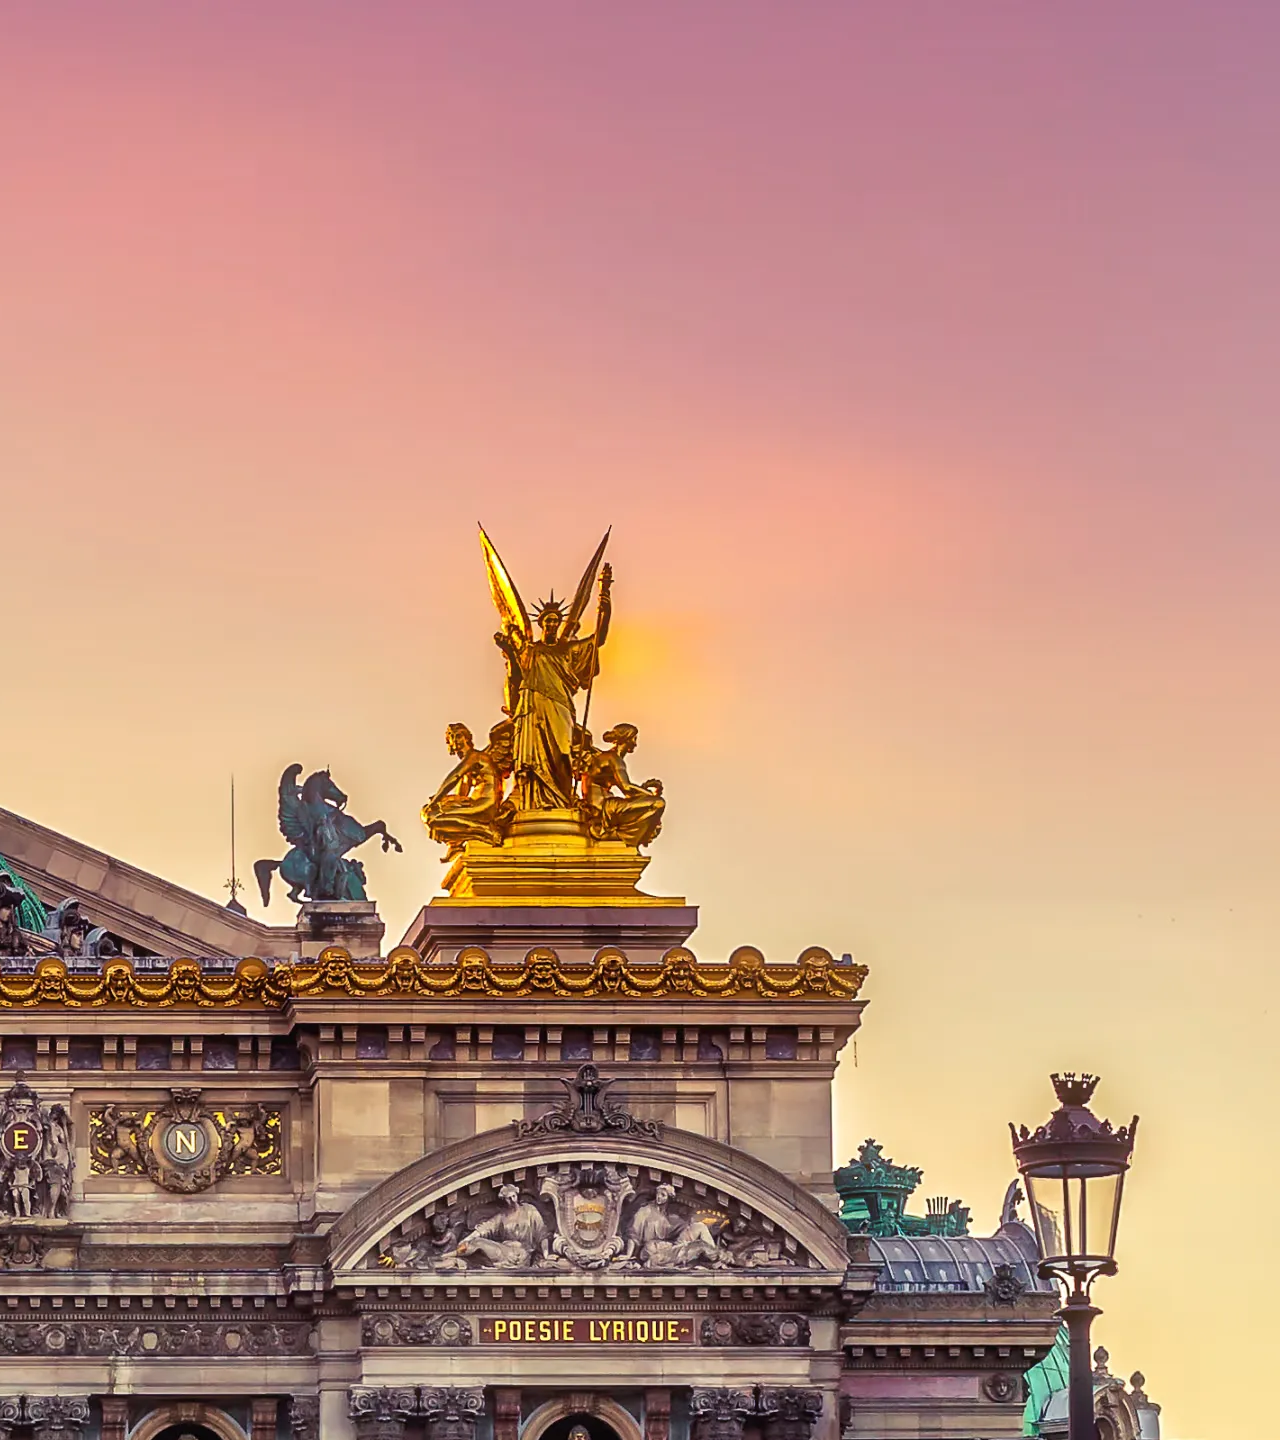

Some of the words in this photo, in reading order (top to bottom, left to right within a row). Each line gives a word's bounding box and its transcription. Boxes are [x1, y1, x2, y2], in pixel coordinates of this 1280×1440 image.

[12, 1129, 29, 1150] E
[174, 1129, 197, 1154] N
[494, 1320, 574, 1341] POESIE
[589, 1320, 679, 1342] LYRIQUE
